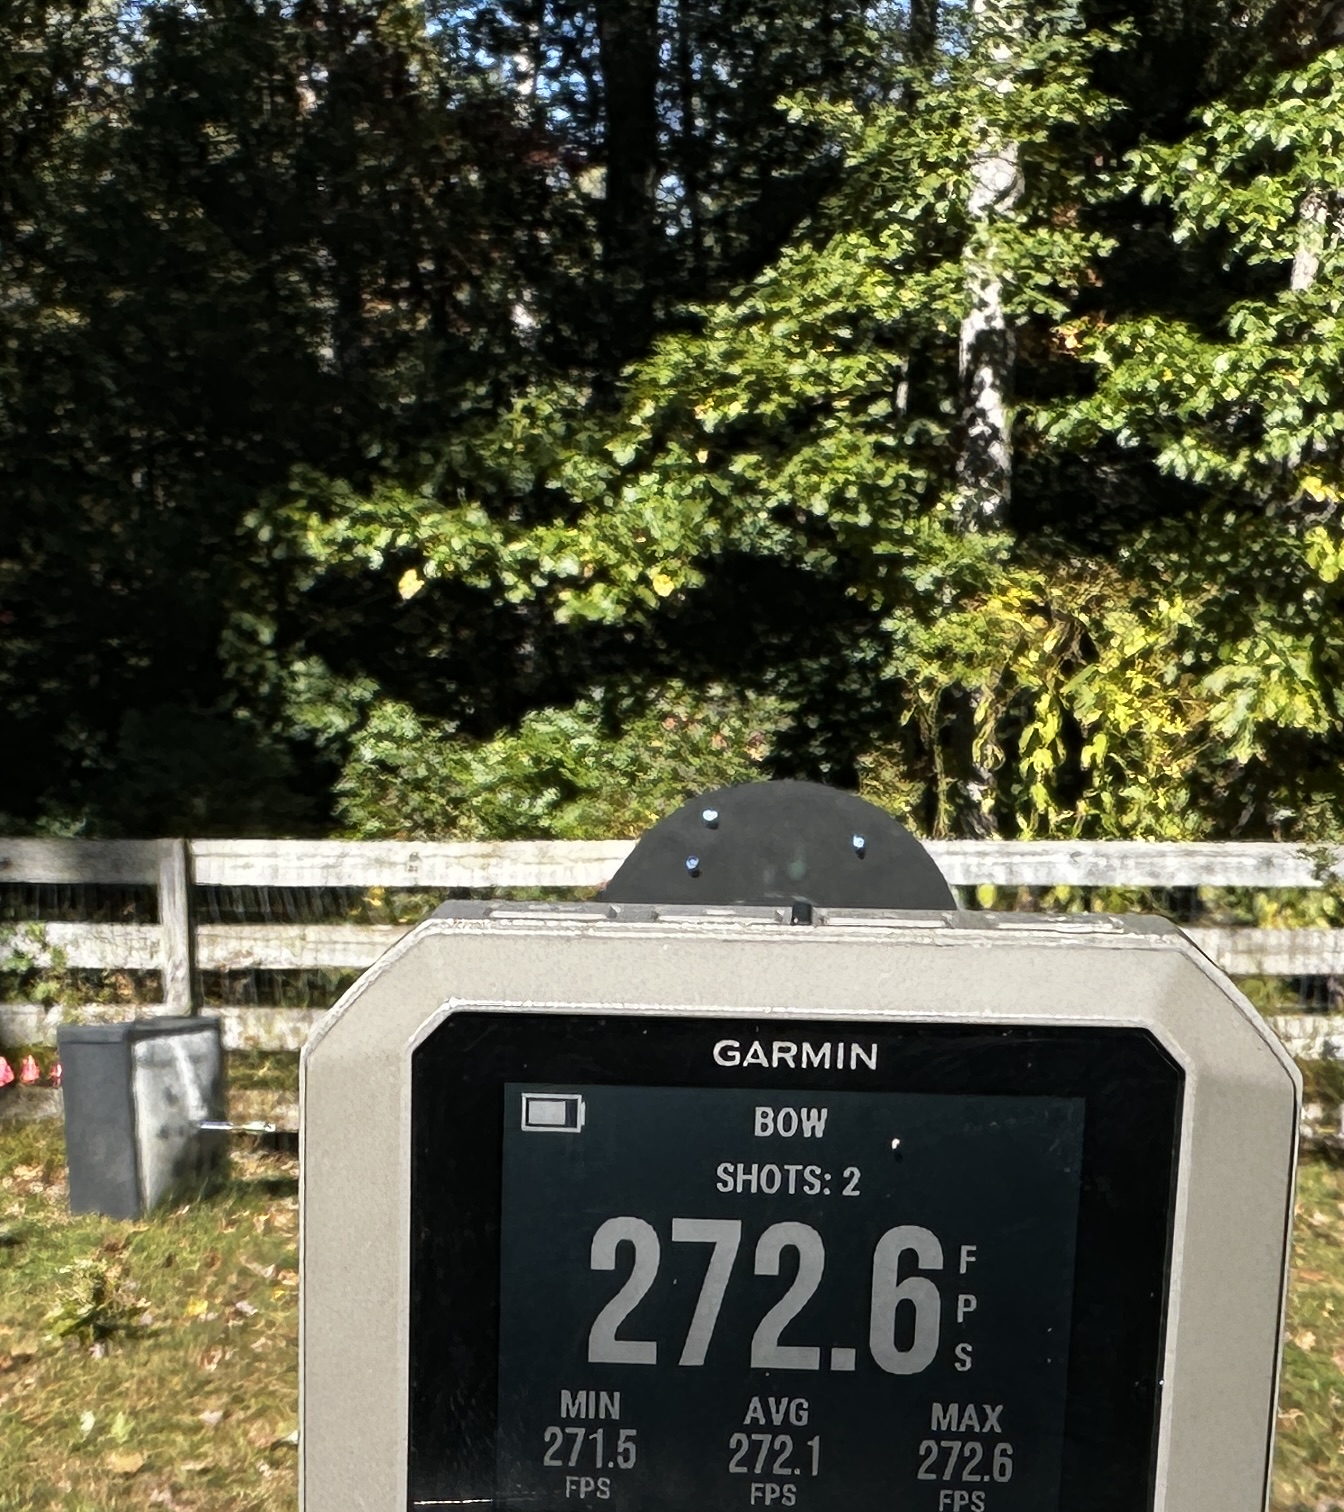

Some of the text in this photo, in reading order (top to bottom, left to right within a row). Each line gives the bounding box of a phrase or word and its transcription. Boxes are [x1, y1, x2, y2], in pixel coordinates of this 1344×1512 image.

[712, 1039, 878, 1071] GARMIN
[754, 1106, 828, 1138] BOW
[716, 1162, 862, 1196] SHOTS: 2
[588, 1216, 944, 1376] 272.6
[559, 1390, 621, 1420] MIN
[743, 1396, 809, 1427] AVG
[931, 1403, 1004, 1434] MAX
[543, 1426, 638, 1470] 271.5
[728, 1433, 821, 1477] 272.1
[916, 1440, 1014, 1484] 272.6
[565, 1477, 611, 1500] FPS
[751, 1483, 798, 1507] FPS
